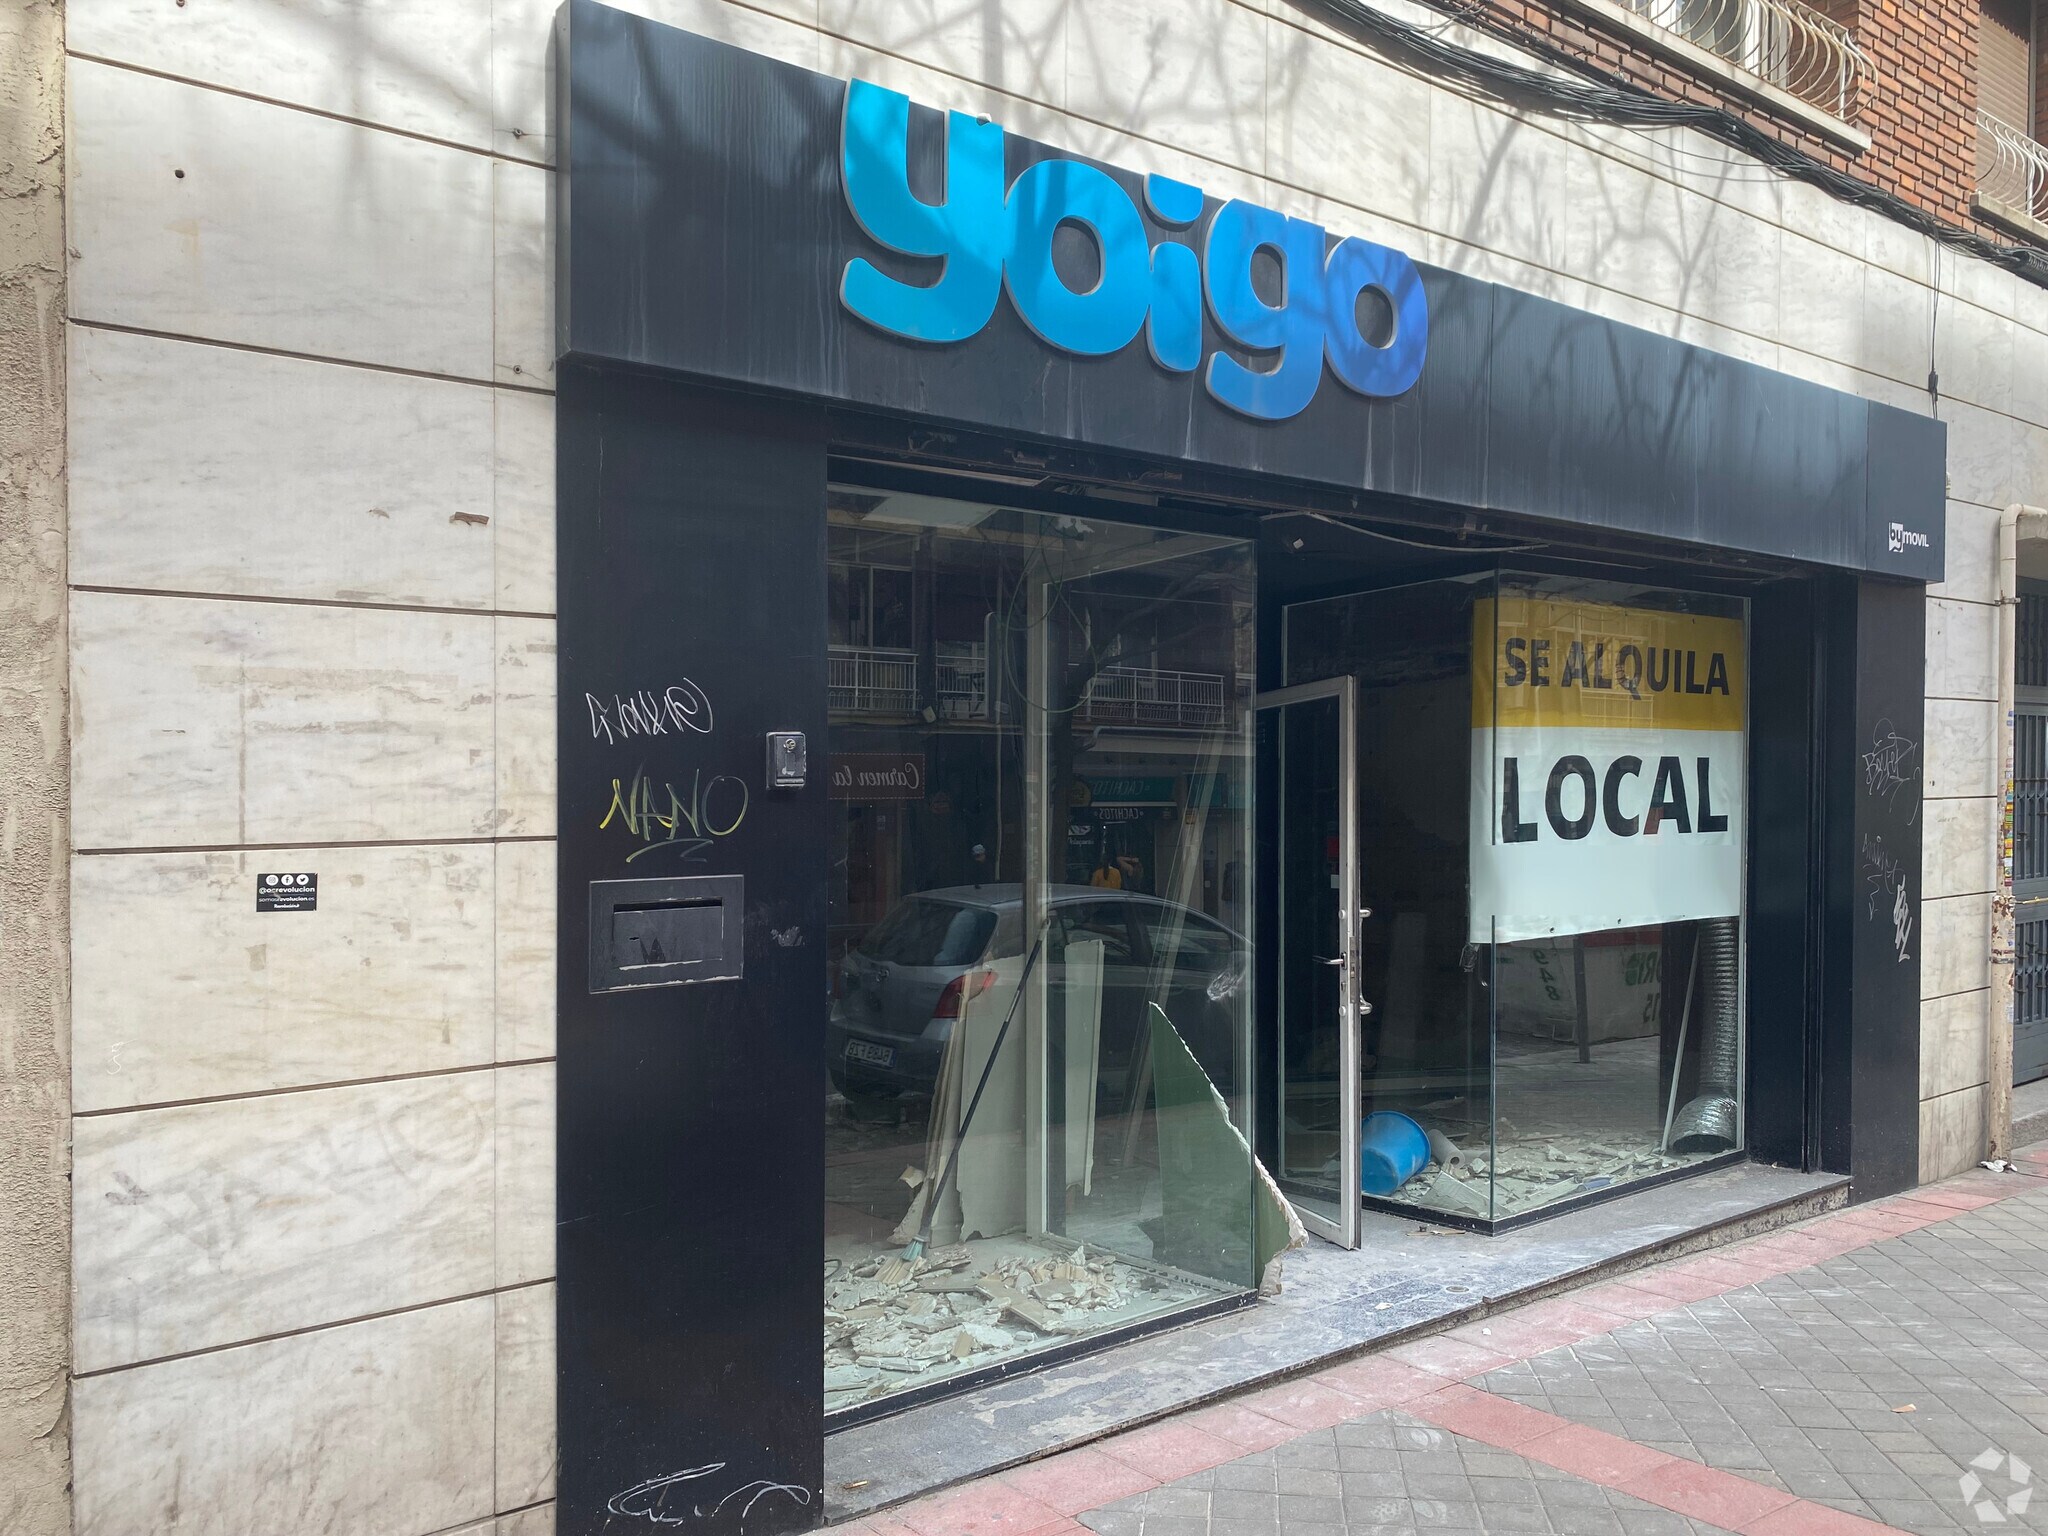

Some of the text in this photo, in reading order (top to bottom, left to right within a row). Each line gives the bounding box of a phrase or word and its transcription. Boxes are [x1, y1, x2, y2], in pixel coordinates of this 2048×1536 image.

[840, 78, 1429, 419] yoigo
[1504, 637, 1730, 701] SE ALQUILA
[1501, 754, 1729, 844] LOCAL
